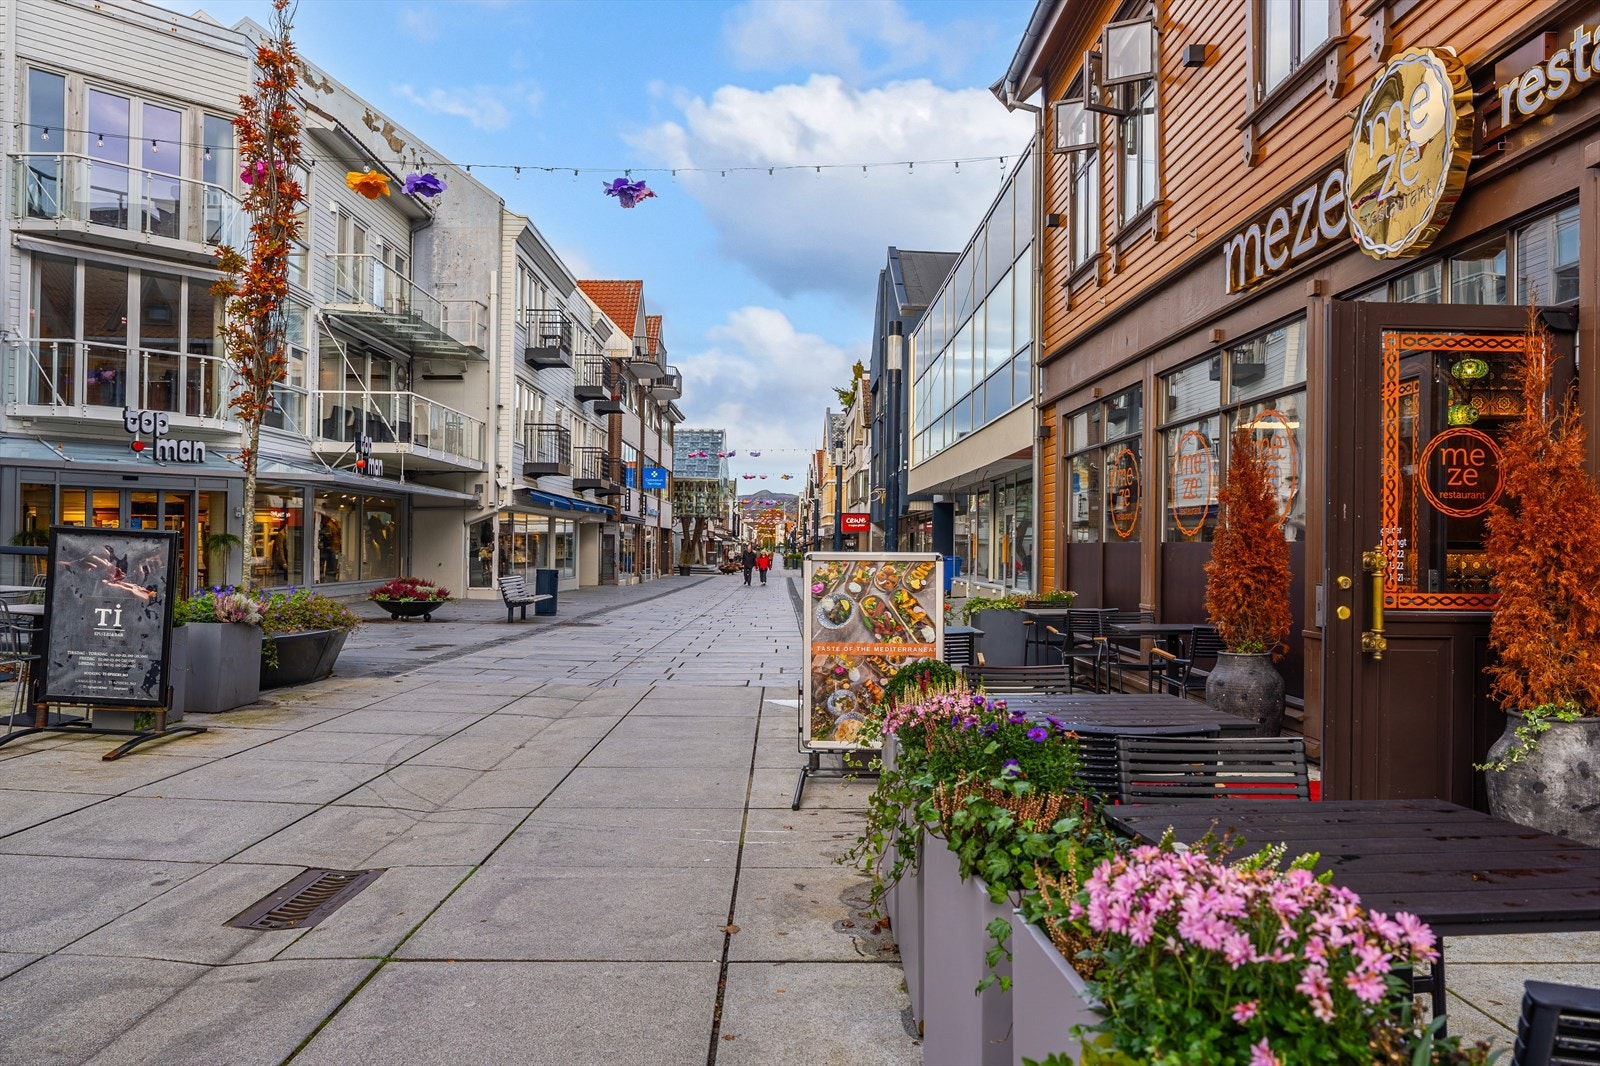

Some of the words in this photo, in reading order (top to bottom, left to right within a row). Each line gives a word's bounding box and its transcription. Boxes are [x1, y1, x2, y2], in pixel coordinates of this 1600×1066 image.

[1366, 82, 1430, 160] me
[1376, 140, 1421, 201] ze
[1362, 177, 1433, 228] restaurant
[1223, 168, 1348, 296] meze
[123, 406, 169, 438] top
[153, 437, 206, 463] man
[1440, 447, 1485, 467] me
[1180, 452, 1203, 475] me
[1183, 477, 1199, 499] ze
[1447, 468, 1478, 487] ze
[1440, 491, 1486, 500] restaurant
[94, 603, 122, 627] Ti
